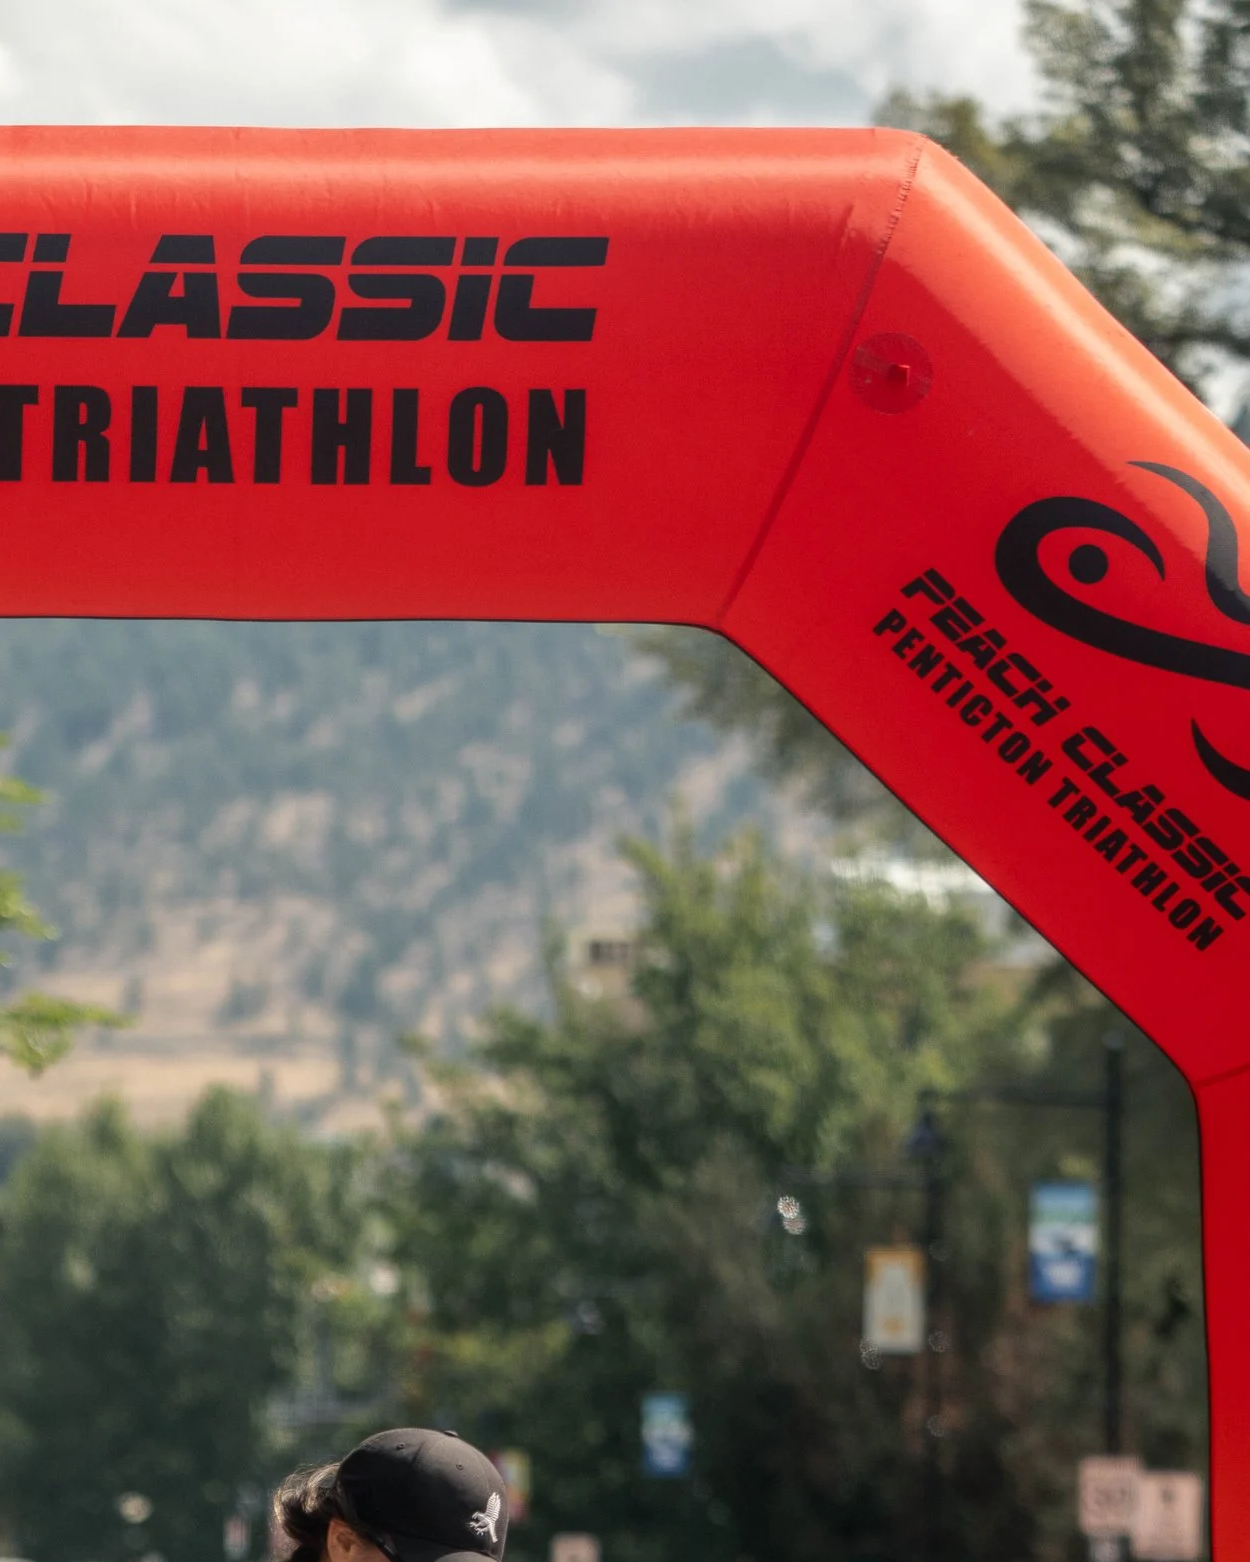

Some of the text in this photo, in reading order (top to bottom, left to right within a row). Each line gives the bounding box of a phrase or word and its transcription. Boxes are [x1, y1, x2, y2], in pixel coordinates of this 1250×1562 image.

[873, 609, 1223, 951] PENTICTON TRIATHLON
[901, 568, 1250, 920] PEACH CLASSIC
